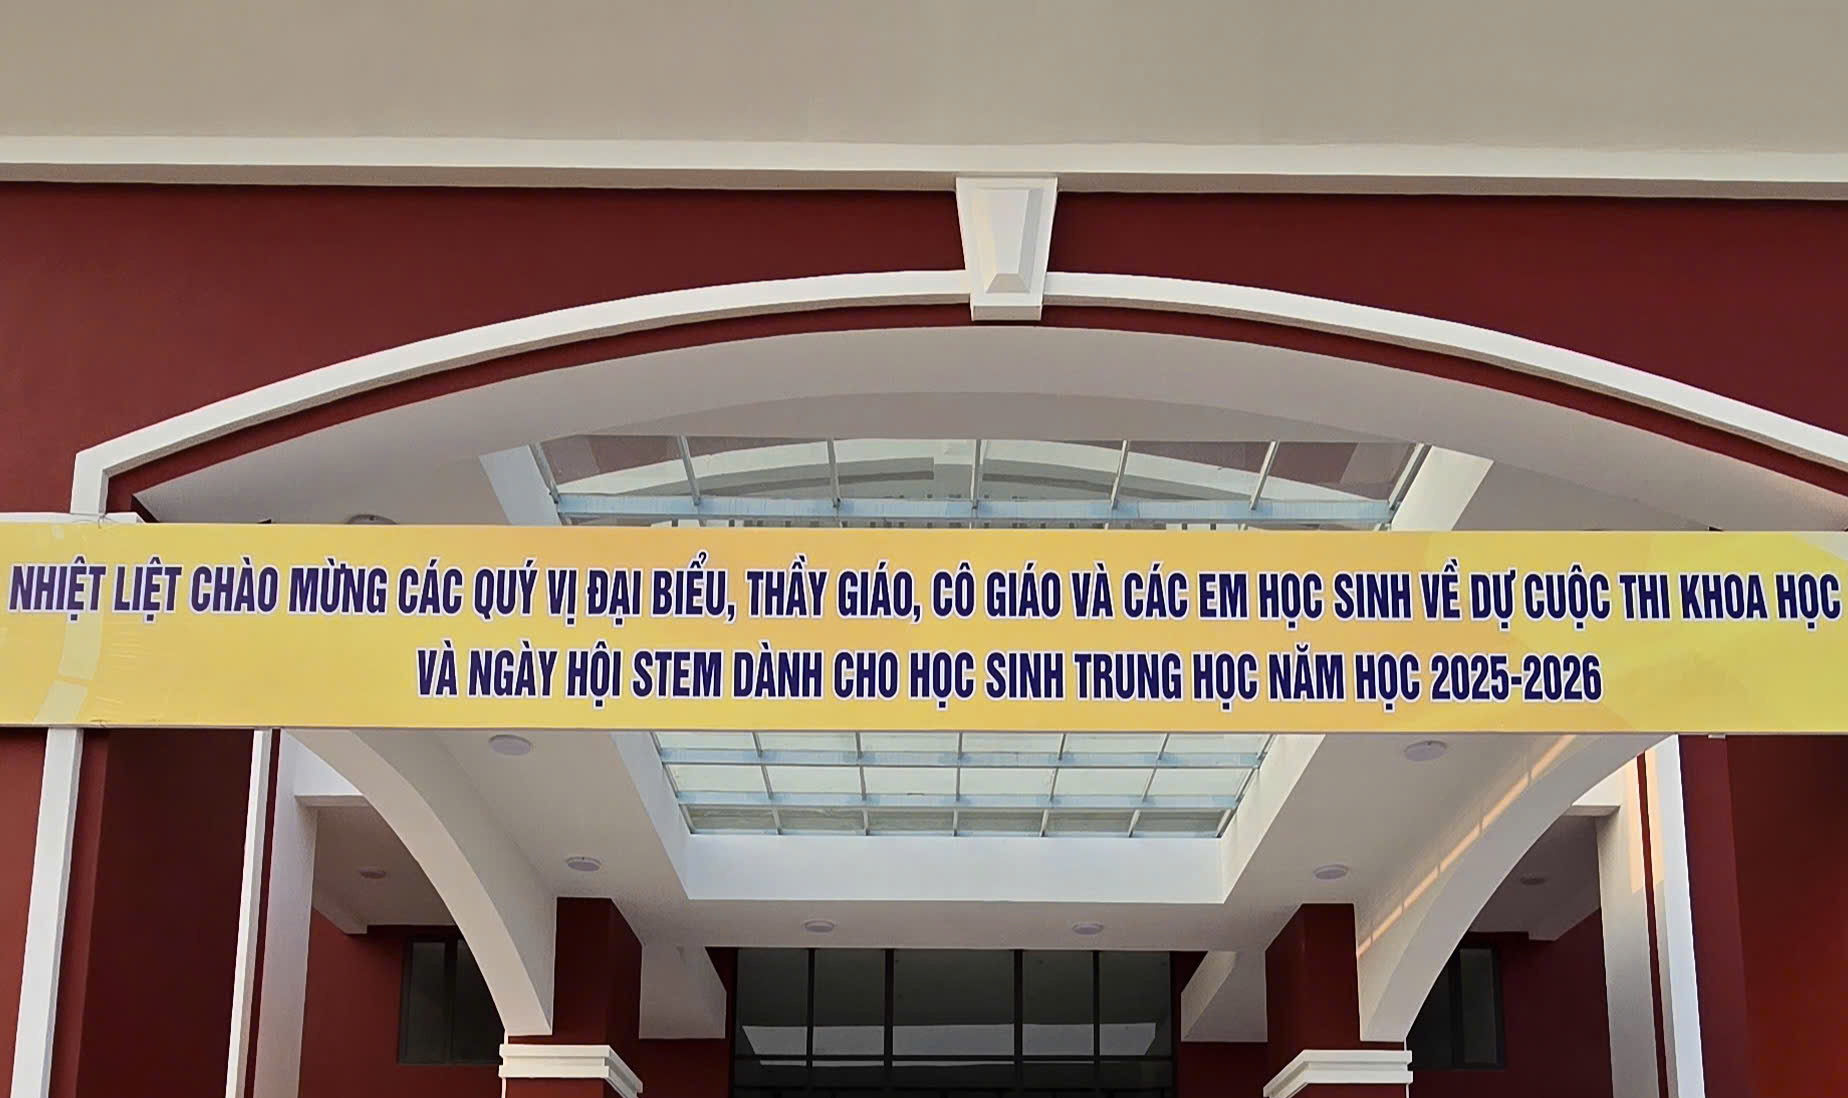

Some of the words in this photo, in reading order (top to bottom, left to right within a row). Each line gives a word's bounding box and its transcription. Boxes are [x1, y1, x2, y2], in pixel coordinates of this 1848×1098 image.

[8, 554, 108, 622] NHIỆT
[113, 555, 184, 623] LIỆT
[190, 555, 279, 614] CHÀO
[287, 556, 389, 615] MỪNG
[397, 557, 464, 615] CÁC
[473, 558, 539, 621] QUÝ
[546, 568, 580, 626] VỊ
[586, 568, 643, 627] ĐẠI
[651, 550, 736, 623] BIỂU,
[745, 554, 829, 617] THẦY
[837, 560, 922, 624] GIÁO,
[932, 561, 984, 618] CÔ
[985, 561, 1062, 619] GIÁO
[1070, 561, 1115, 618] VÀ
[1123, 562, 1189, 619] CÁC
[1197, 572, 1249, 619] EM
[1257, 571, 1324, 630] HỌC
[1333, 572, 1413, 620] SINH
[1419, 557, 1462, 620] VỀ
[1469, 568, 1517, 630] DỰ
[1523, 563, 1612, 630] CUỘC
[1618, 573, 1672, 620] THI
[1678, 572, 1769, 620] KHOA
[1774, 572, 1842, 630] HỌC
[416, 638, 459, 697] VÀ
[467, 639, 559, 698] NGÀY
[566, 639, 623, 709] HỘI
[631, 649, 723, 698] STEM
[732, 640, 824, 699] DÀNH
[833, 650, 899, 699] CHO
[909, 650, 975, 710] HỌC
[985, 650, 1065, 700] SINH
[1073, 651, 1183, 701] TRUNG
[1191, 652, 1259, 712] HỌC
[1267, 642, 1346, 701] NĂM
[1354, 652, 1421, 712] HỌC
[1430, 653, 1603, 702] 2025-2026
